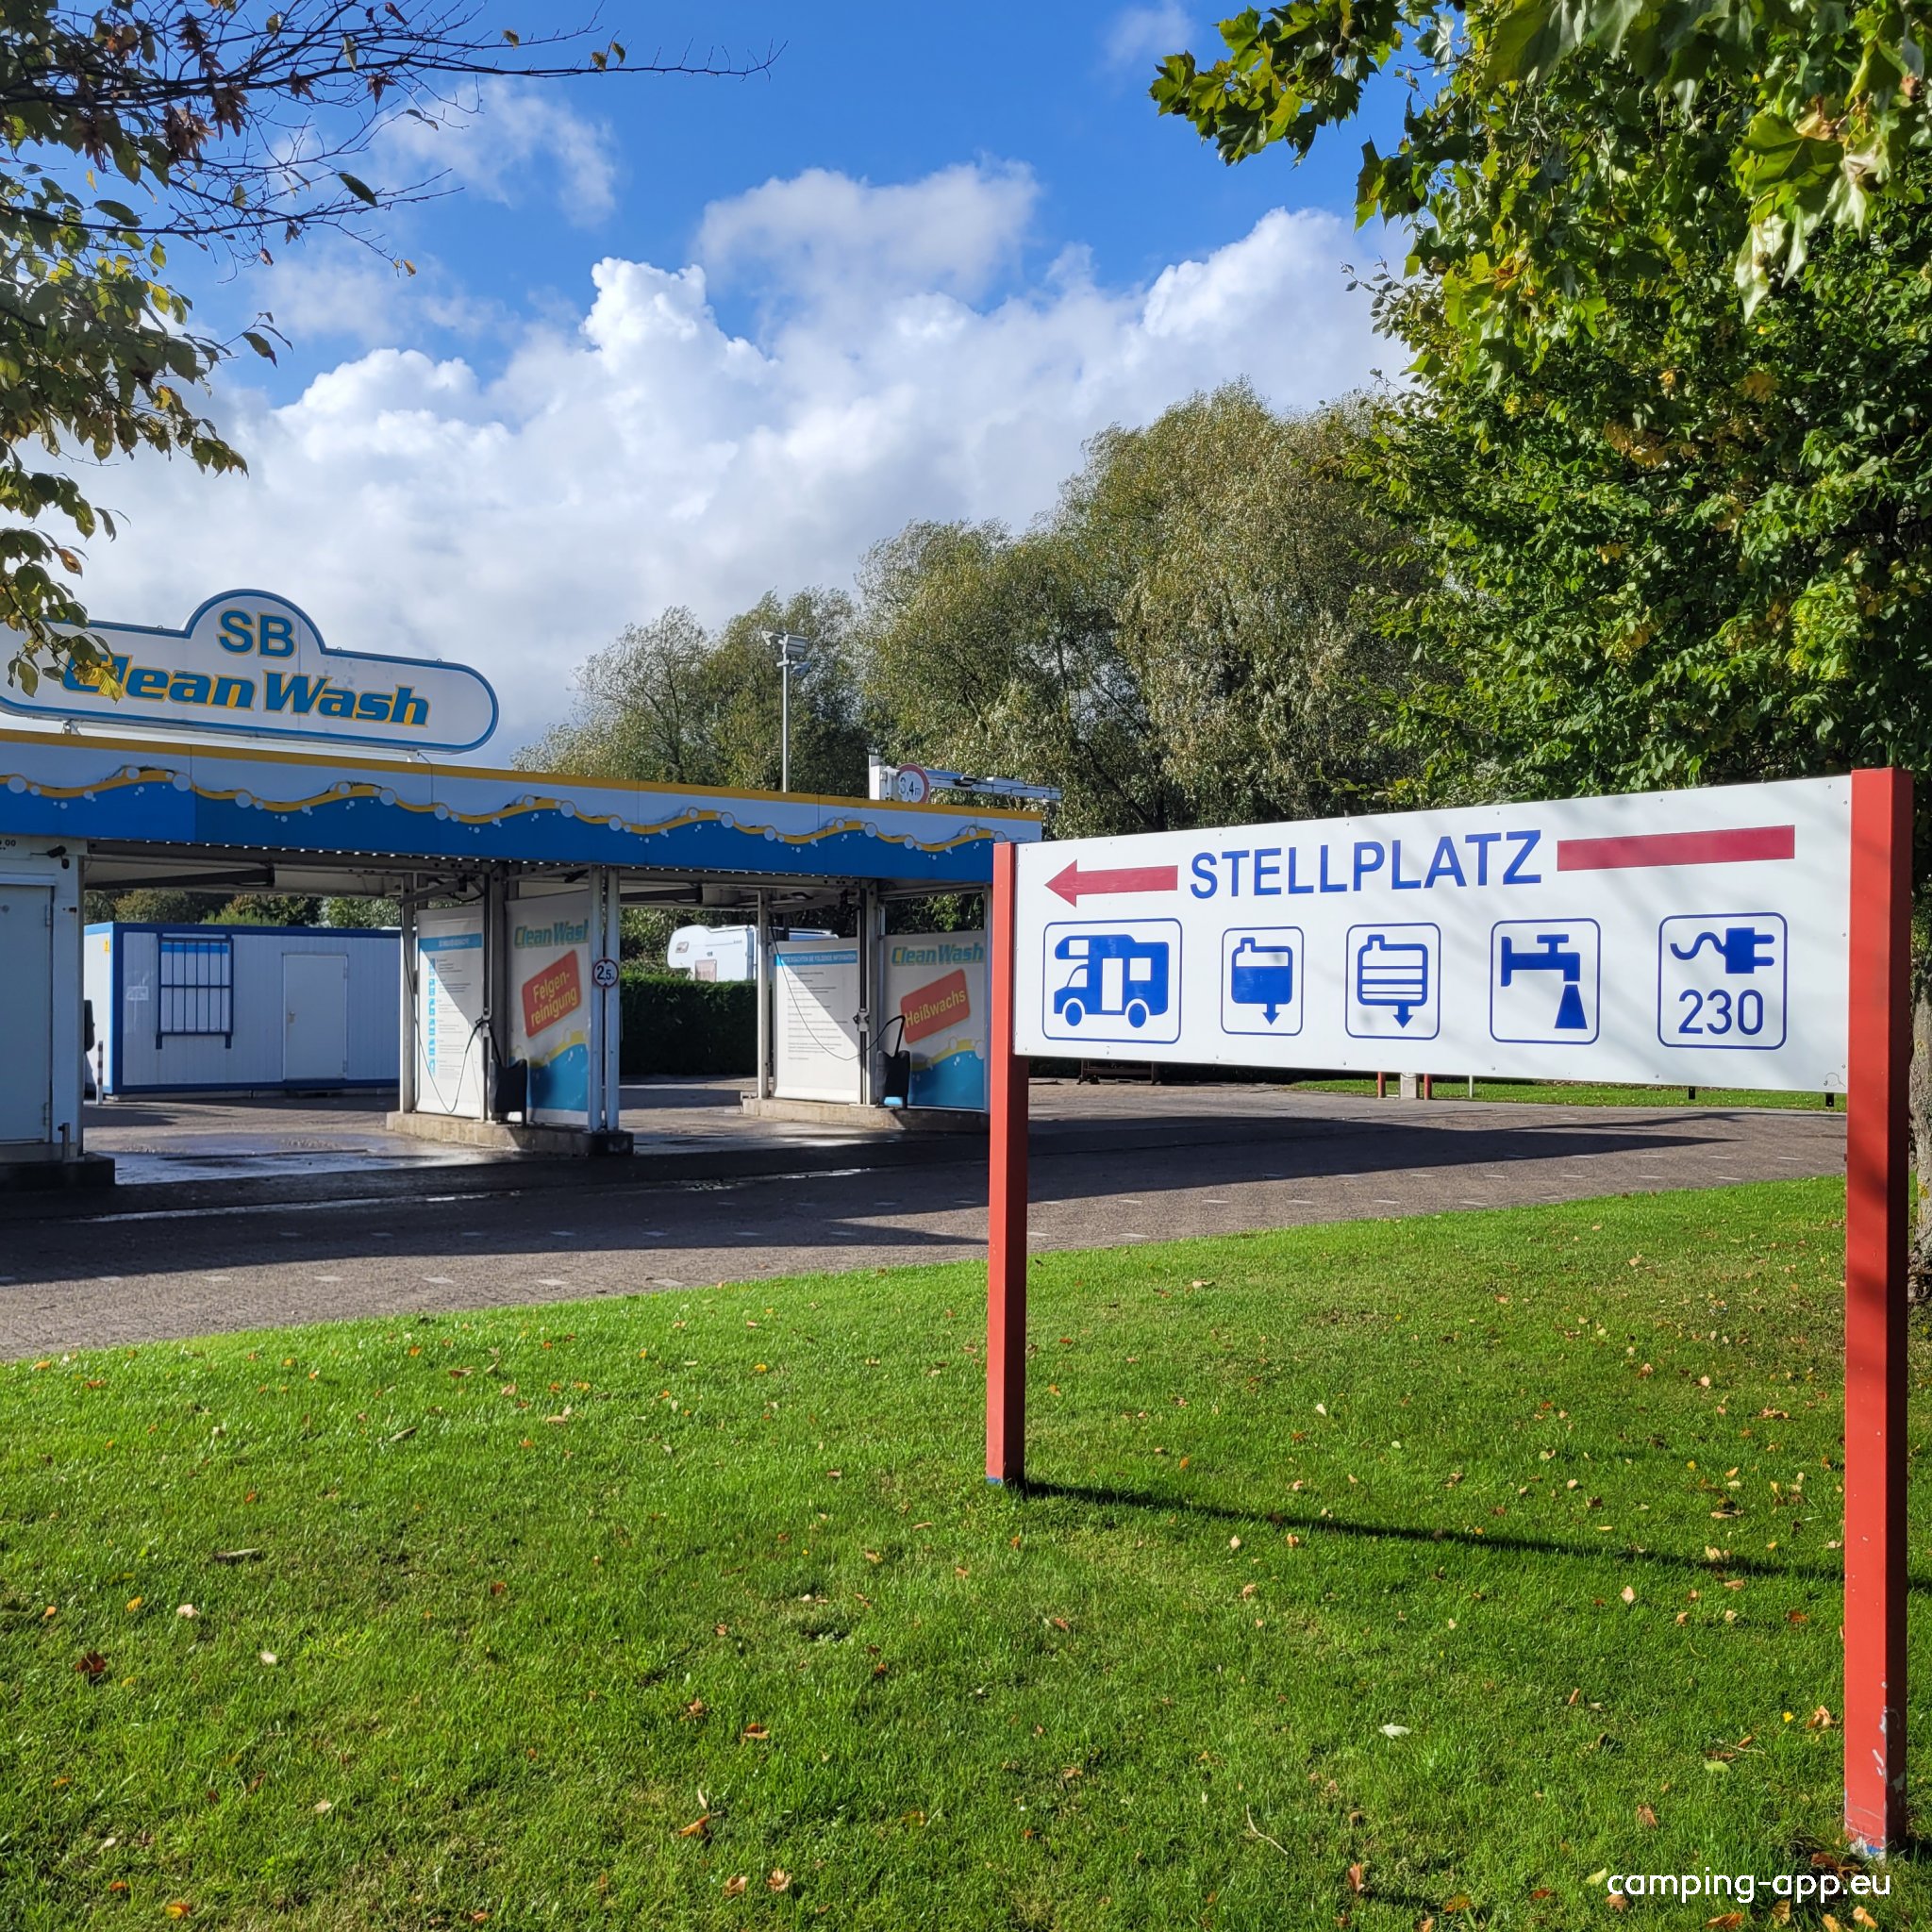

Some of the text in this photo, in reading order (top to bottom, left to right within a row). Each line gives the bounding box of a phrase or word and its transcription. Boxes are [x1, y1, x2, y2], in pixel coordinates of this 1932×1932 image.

[216, 608, 298, 659] SB
[263, 669, 431, 728] Wash
[1191, 829, 1542, 900] STELLPLATZ
[530, 986, 578, 1028] reinigung
[532, 971, 571, 1005] Felgen-
[905, 990, 967, 1029] Heißwachs
[1678, 989, 1765, 1036] 230
